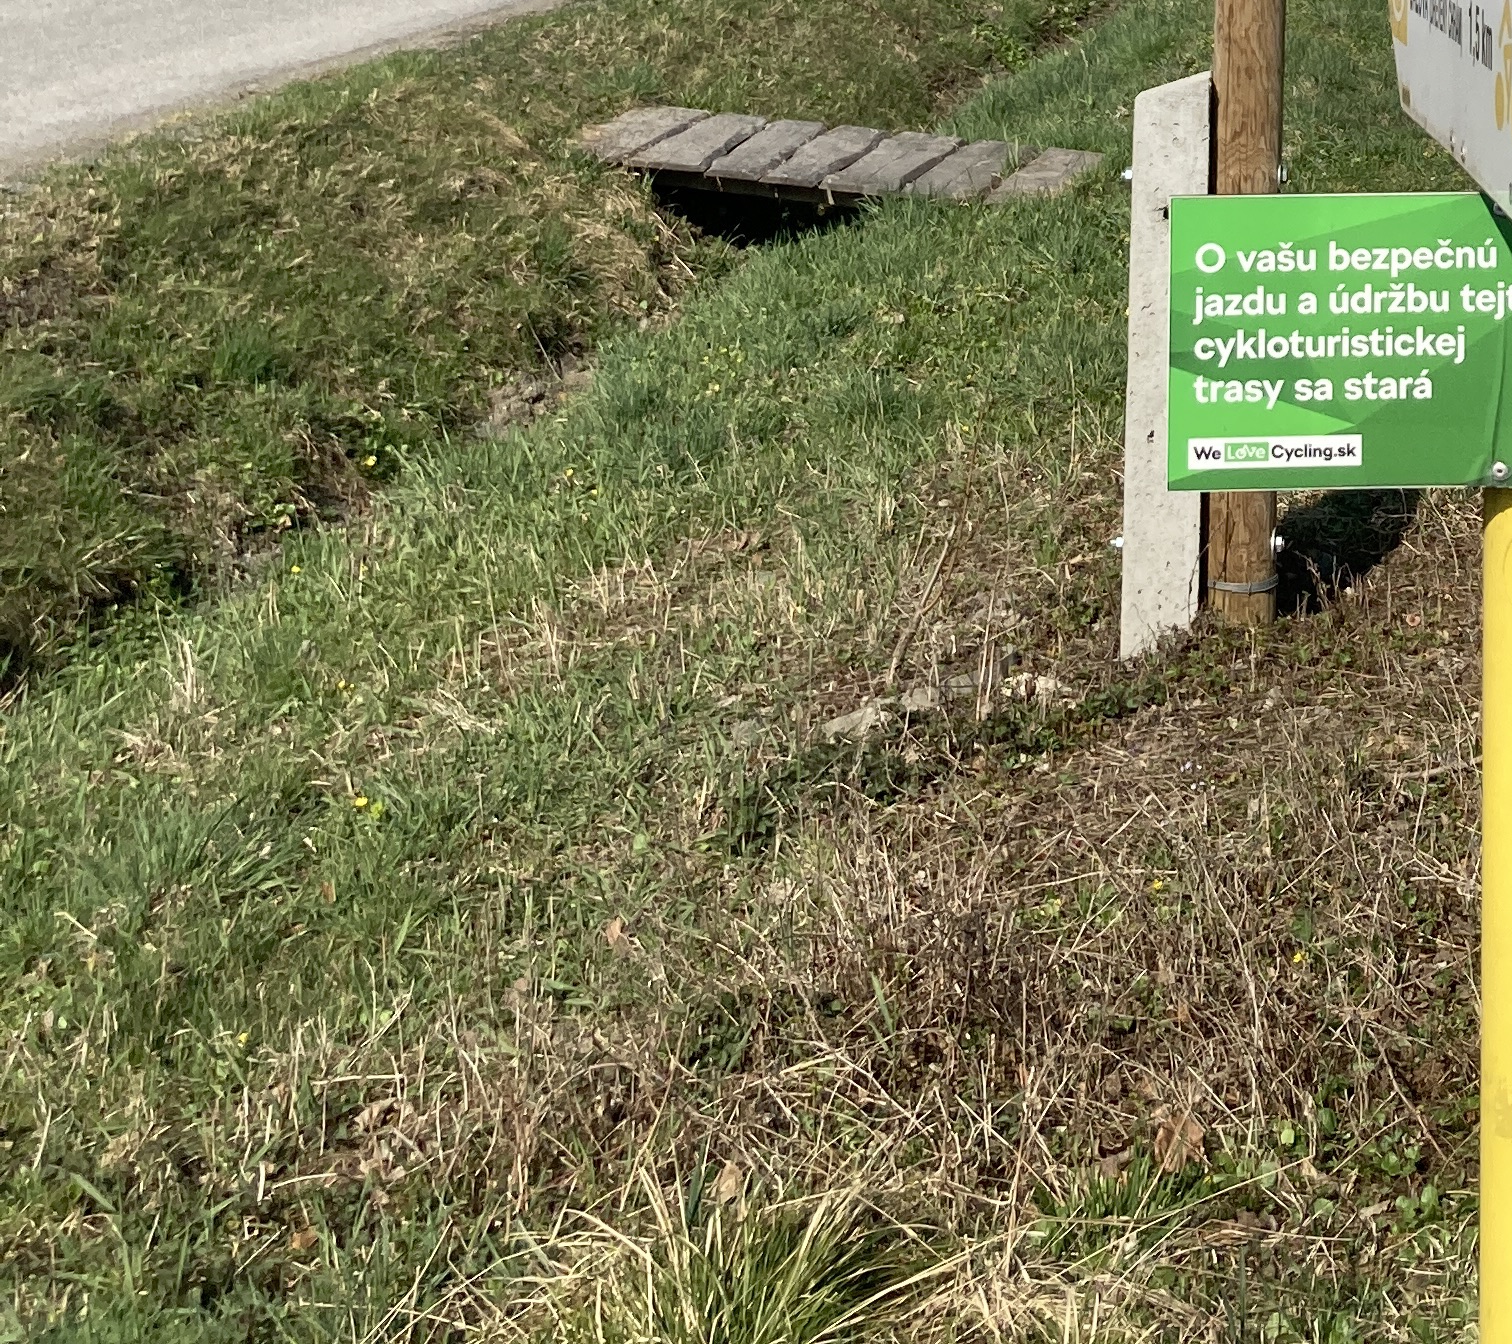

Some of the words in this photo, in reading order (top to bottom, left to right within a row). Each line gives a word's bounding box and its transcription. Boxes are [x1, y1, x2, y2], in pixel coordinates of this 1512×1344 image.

[1469, 0, 1479, 67] 1,5
[1195, 243, 1225, 273] O
[1236, 242, 1316, 272] vašu
[1329, 238, 1497, 278] bezpečnú
[1193, 286, 1286, 325] jazdu
[1298, 293, 1317, 314] a
[1329, 283, 1449, 314] údržbu
[1193, 326, 1466, 367] cykloturistickej
[1193, 377, 1285, 409] trasy
[1295, 379, 1333, 401] sa
[1344, 369, 1432, 400] stará
[1194, 447, 1221, 459] We
[1272, 444, 1355, 461] Cycling.sk
